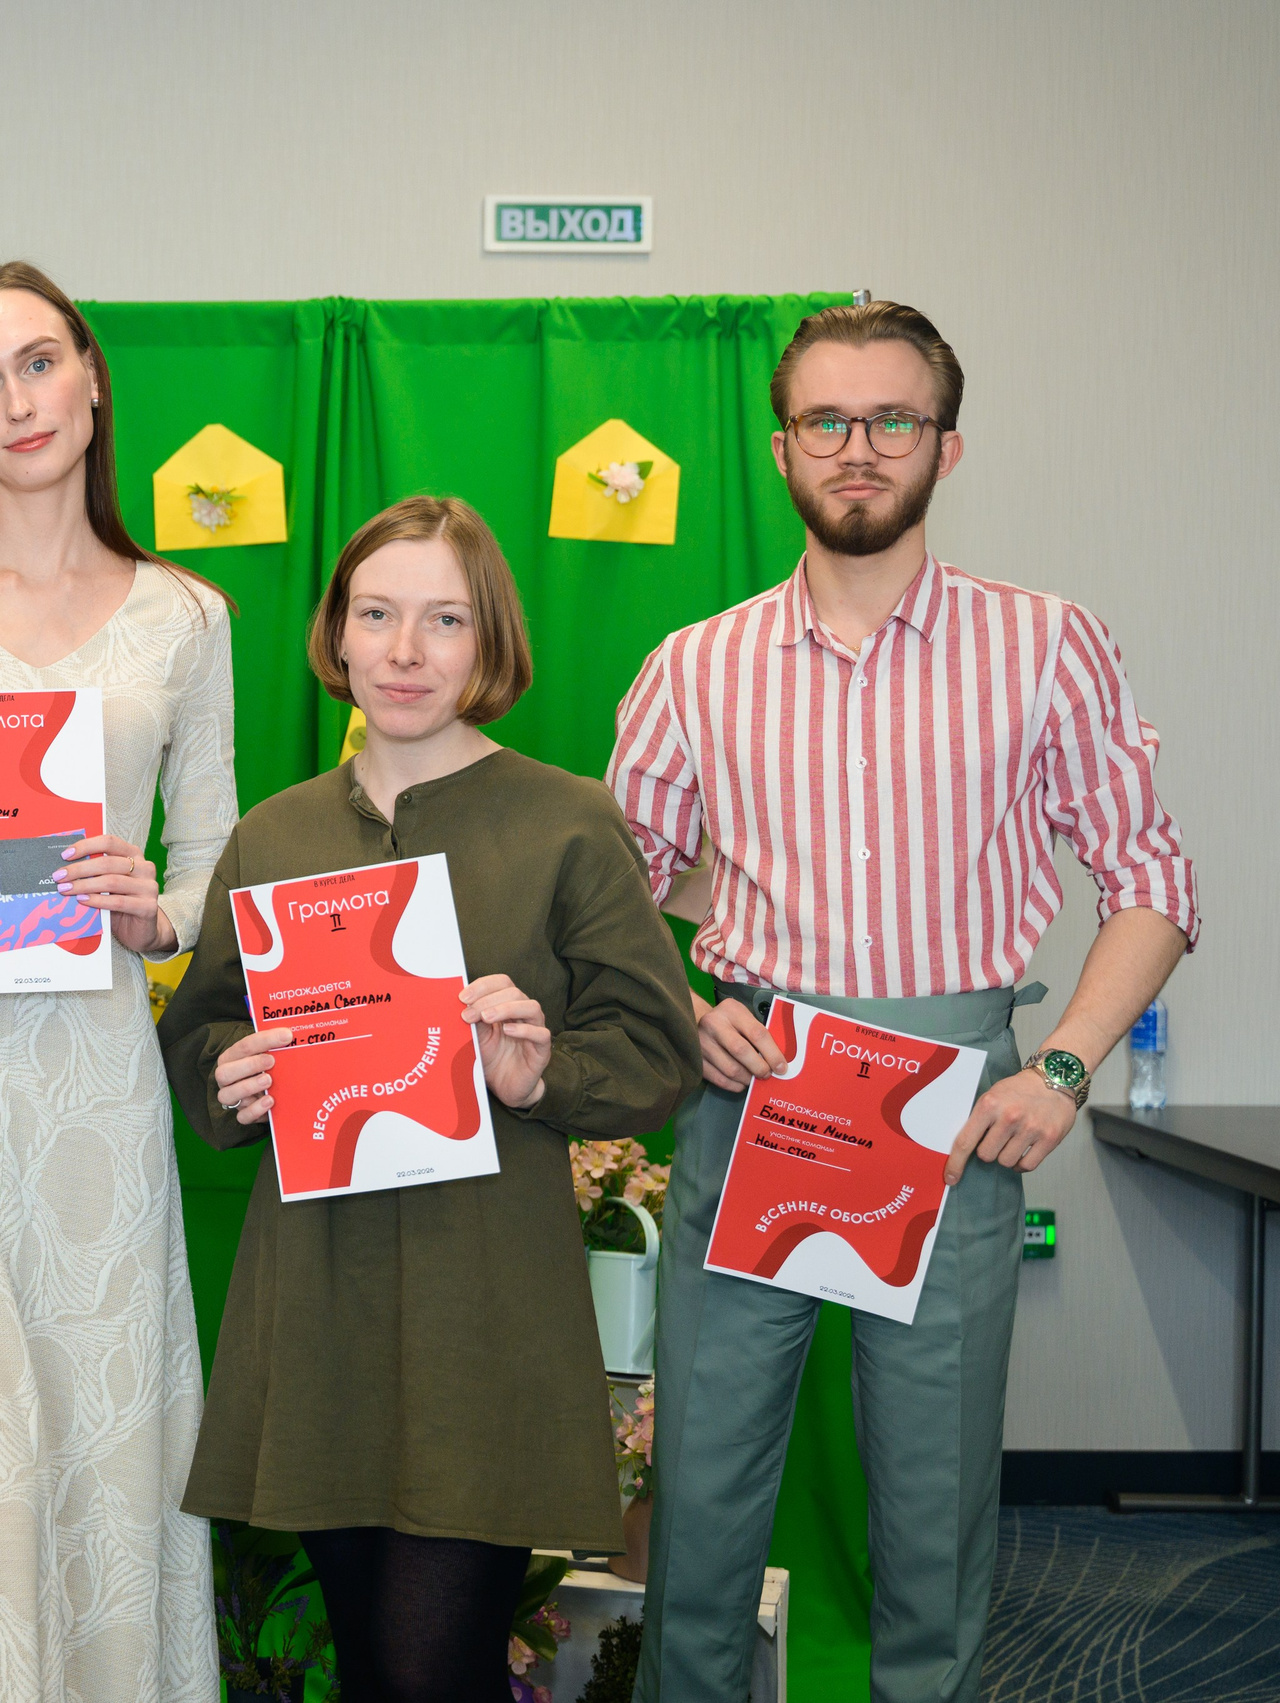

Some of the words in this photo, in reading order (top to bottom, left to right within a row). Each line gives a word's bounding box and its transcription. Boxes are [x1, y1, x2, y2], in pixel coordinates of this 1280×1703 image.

[500, 208, 636, 242] ВЫХОД
[0, 694, 15, 702] ДЕЛА
[320, 877, 337, 887] КУРСЕ
[339, 875, 355, 884] ДЕЛА
[288, 890, 390, 923] Грамота
[269, 980, 351, 1000] награждается
[334, 993, 392, 1009] Светлана
[287, 1023, 314, 1032] астник
[315, 1018, 348, 1028] команды
[861, 1027, 879, 1038] КУРСЕ
[880, 1033, 896, 1042] ДЕЛА
[821, 1032, 920, 1074] Грамота
[312, 1084, 368, 1140] ВЕСЕННЕЕ
[372, 1026, 441, 1096] ОБОСТРЕНИЕ
[769, 1097, 852, 1126] награждается
[770, 1131, 801, 1144] участник
[802, 1140, 834, 1153] команды
[823, 1125, 873, 1149] Михаил
[396, 1168, 434, 1177] 22.03.2026
[755, 1201, 827, 1233] ВЕСЕННЕЕ
[830, 1184, 915, 1224] ОБОСТРЕНИЕ
[820, 1286, 855, 1300] 22.03.2026
